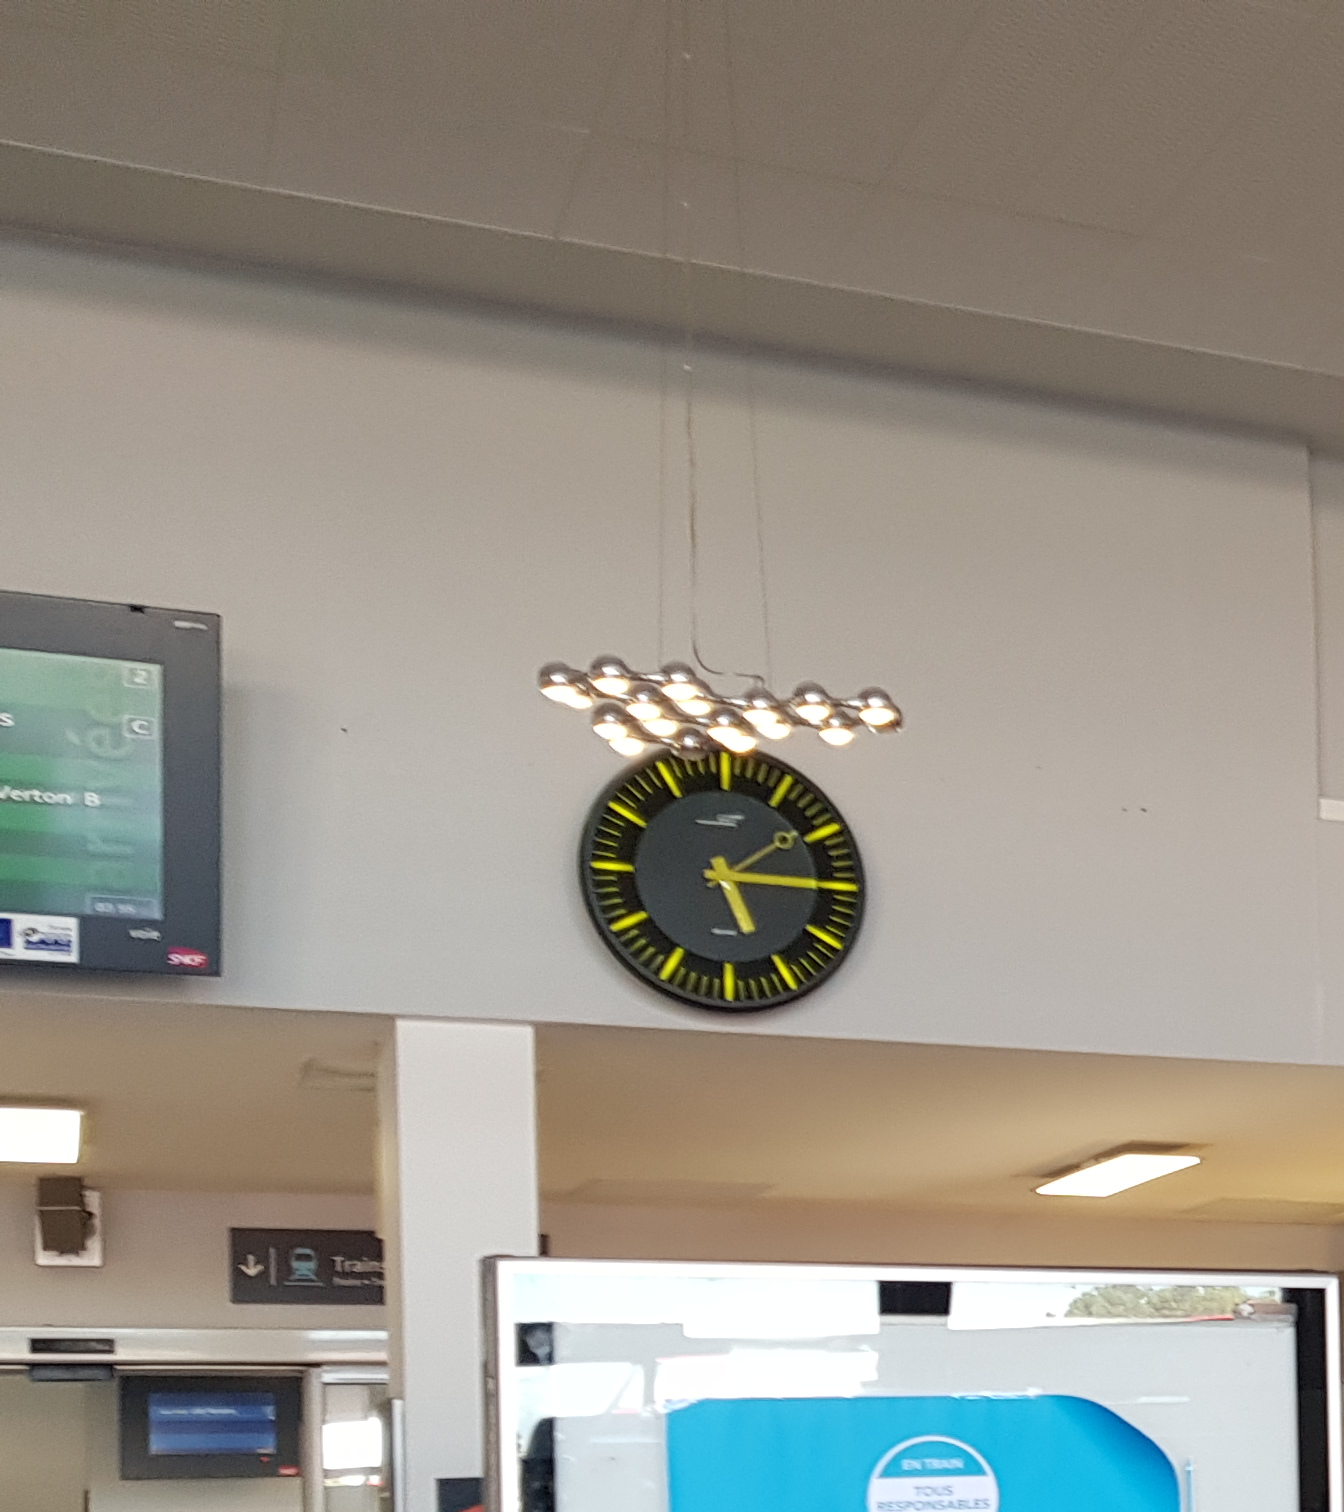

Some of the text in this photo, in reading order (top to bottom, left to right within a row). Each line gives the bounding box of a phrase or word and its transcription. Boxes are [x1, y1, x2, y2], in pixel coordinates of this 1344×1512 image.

[83, 792, 101, 807] B
[901, 1457, 965, 1471] EN TRAIN
[913, 1485, 954, 1497] TOUS
[877, 1498, 991, 1512] RESPONSABLES
